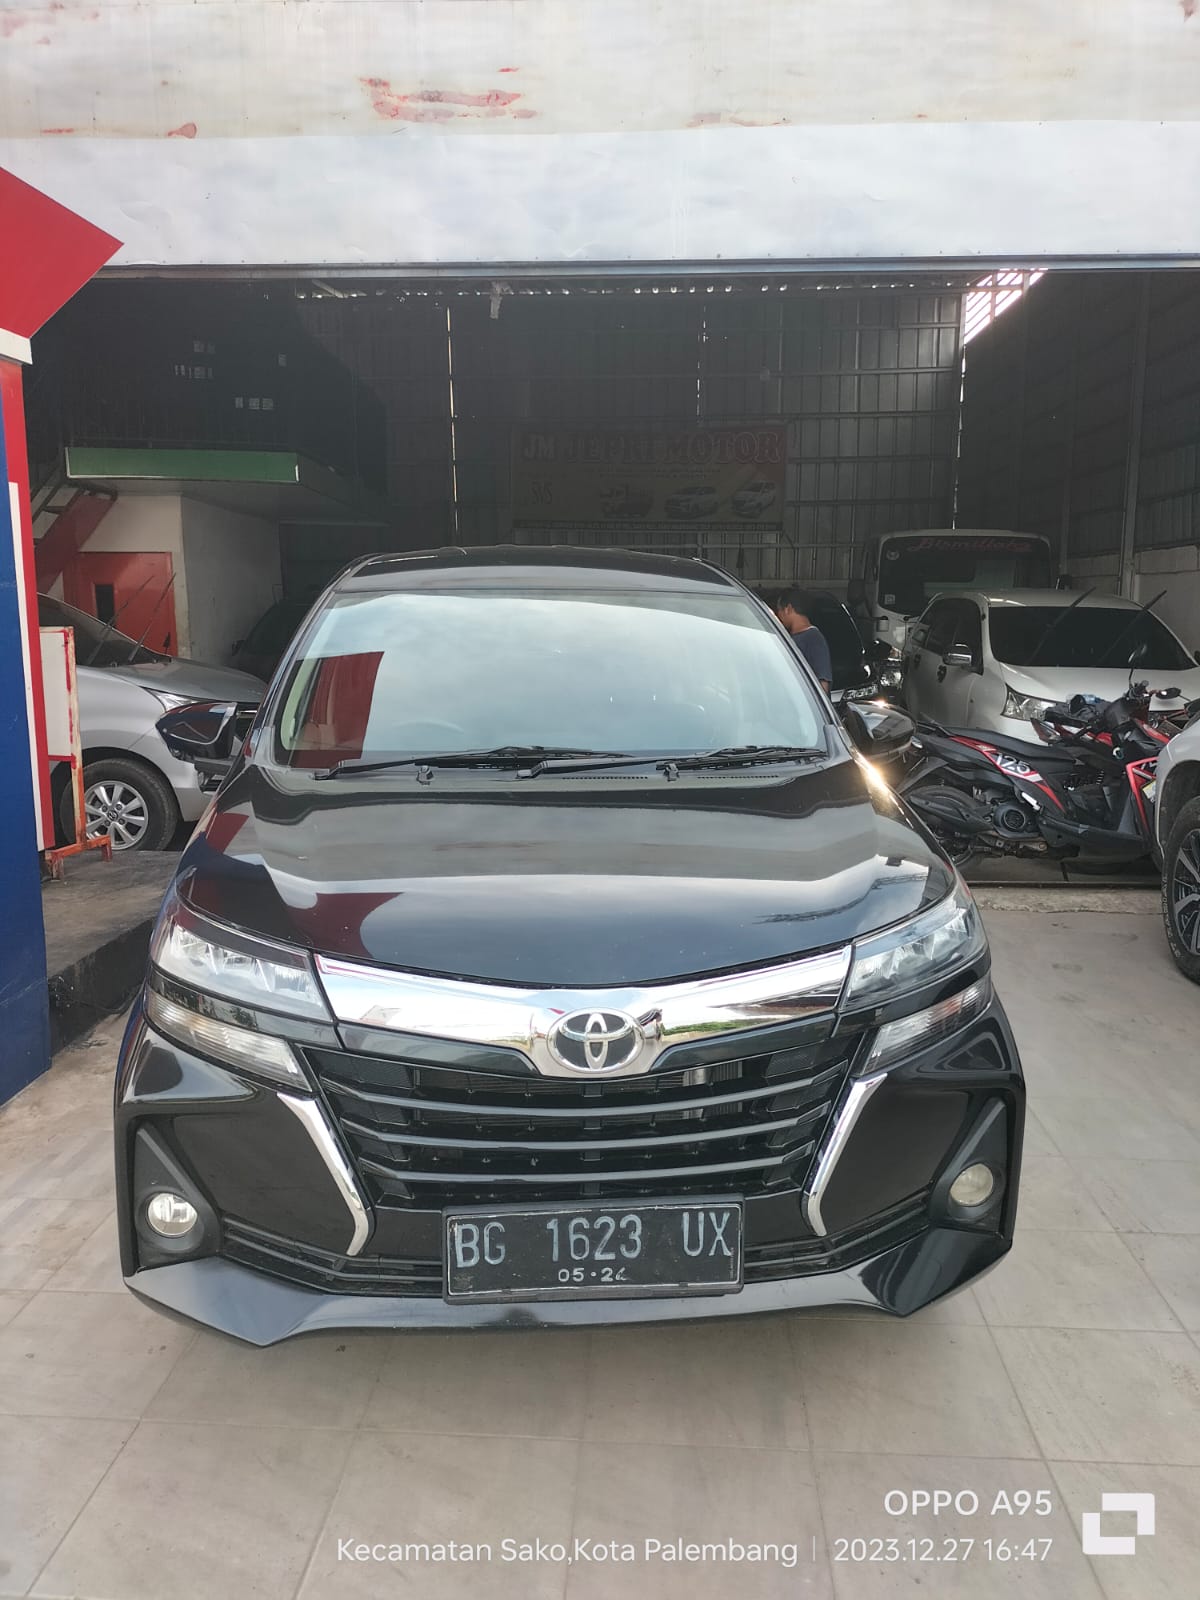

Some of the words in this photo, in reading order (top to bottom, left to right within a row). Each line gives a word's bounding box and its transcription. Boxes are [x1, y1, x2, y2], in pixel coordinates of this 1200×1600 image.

[664, 430, 782, 464] MOTOR
[996, 752, 1031, 774] 125
[454, 1221, 506, 1269] BG
[546, 1213, 643, 1263] 1623
[681, 1211, 732, 1258] UX
